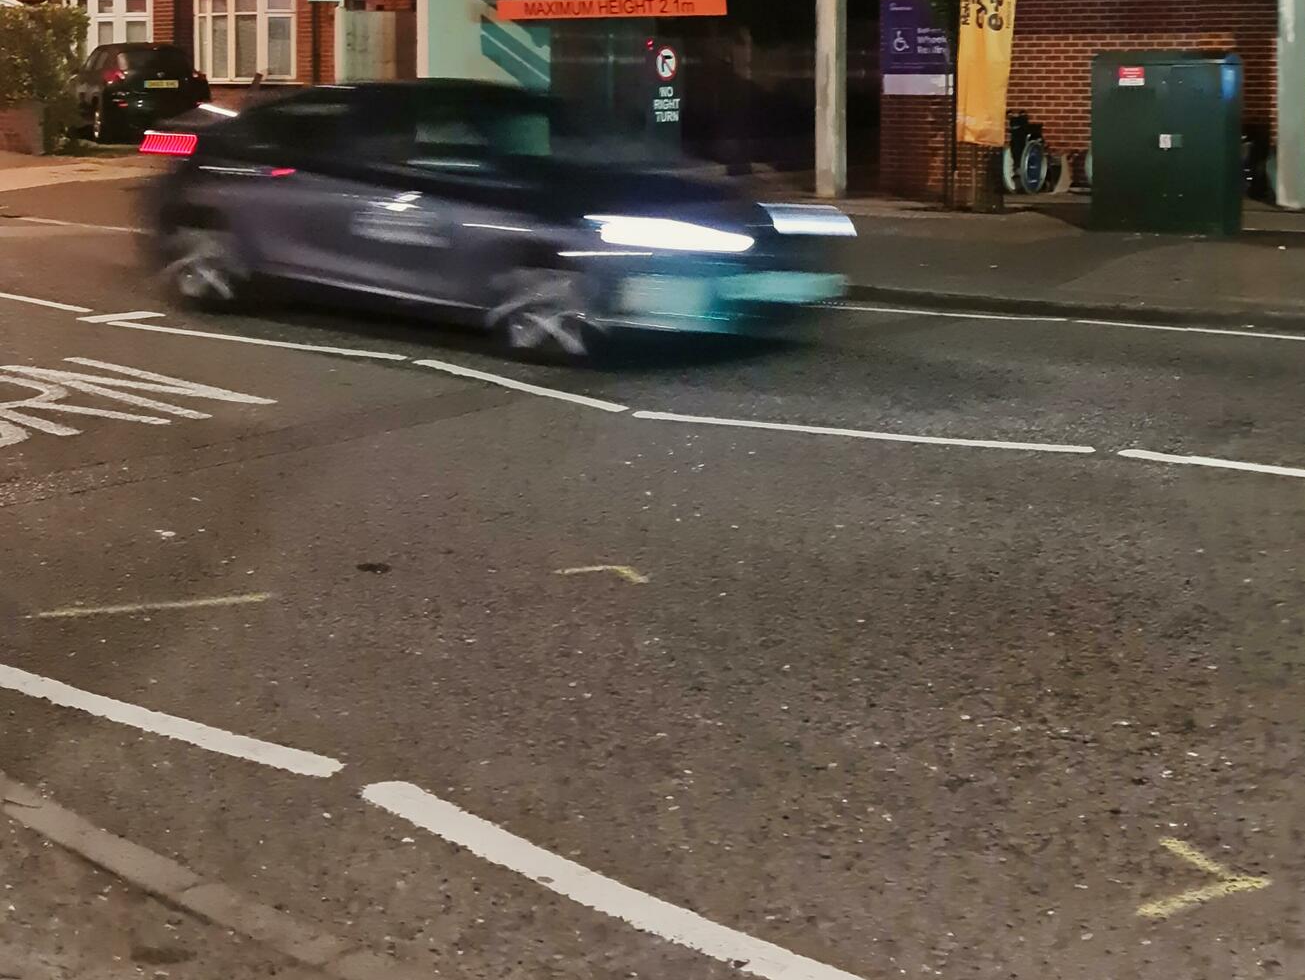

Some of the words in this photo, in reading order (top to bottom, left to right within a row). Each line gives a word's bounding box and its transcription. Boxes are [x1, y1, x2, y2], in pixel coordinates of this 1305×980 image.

[523, 1, 594, 16] MAXIMUM
[599, 0, 655, 15] HEIGHT
[659, 86, 674, 97] NO
[653, 98, 681, 110] RIGHT
[655, 110, 680, 122] TURN
